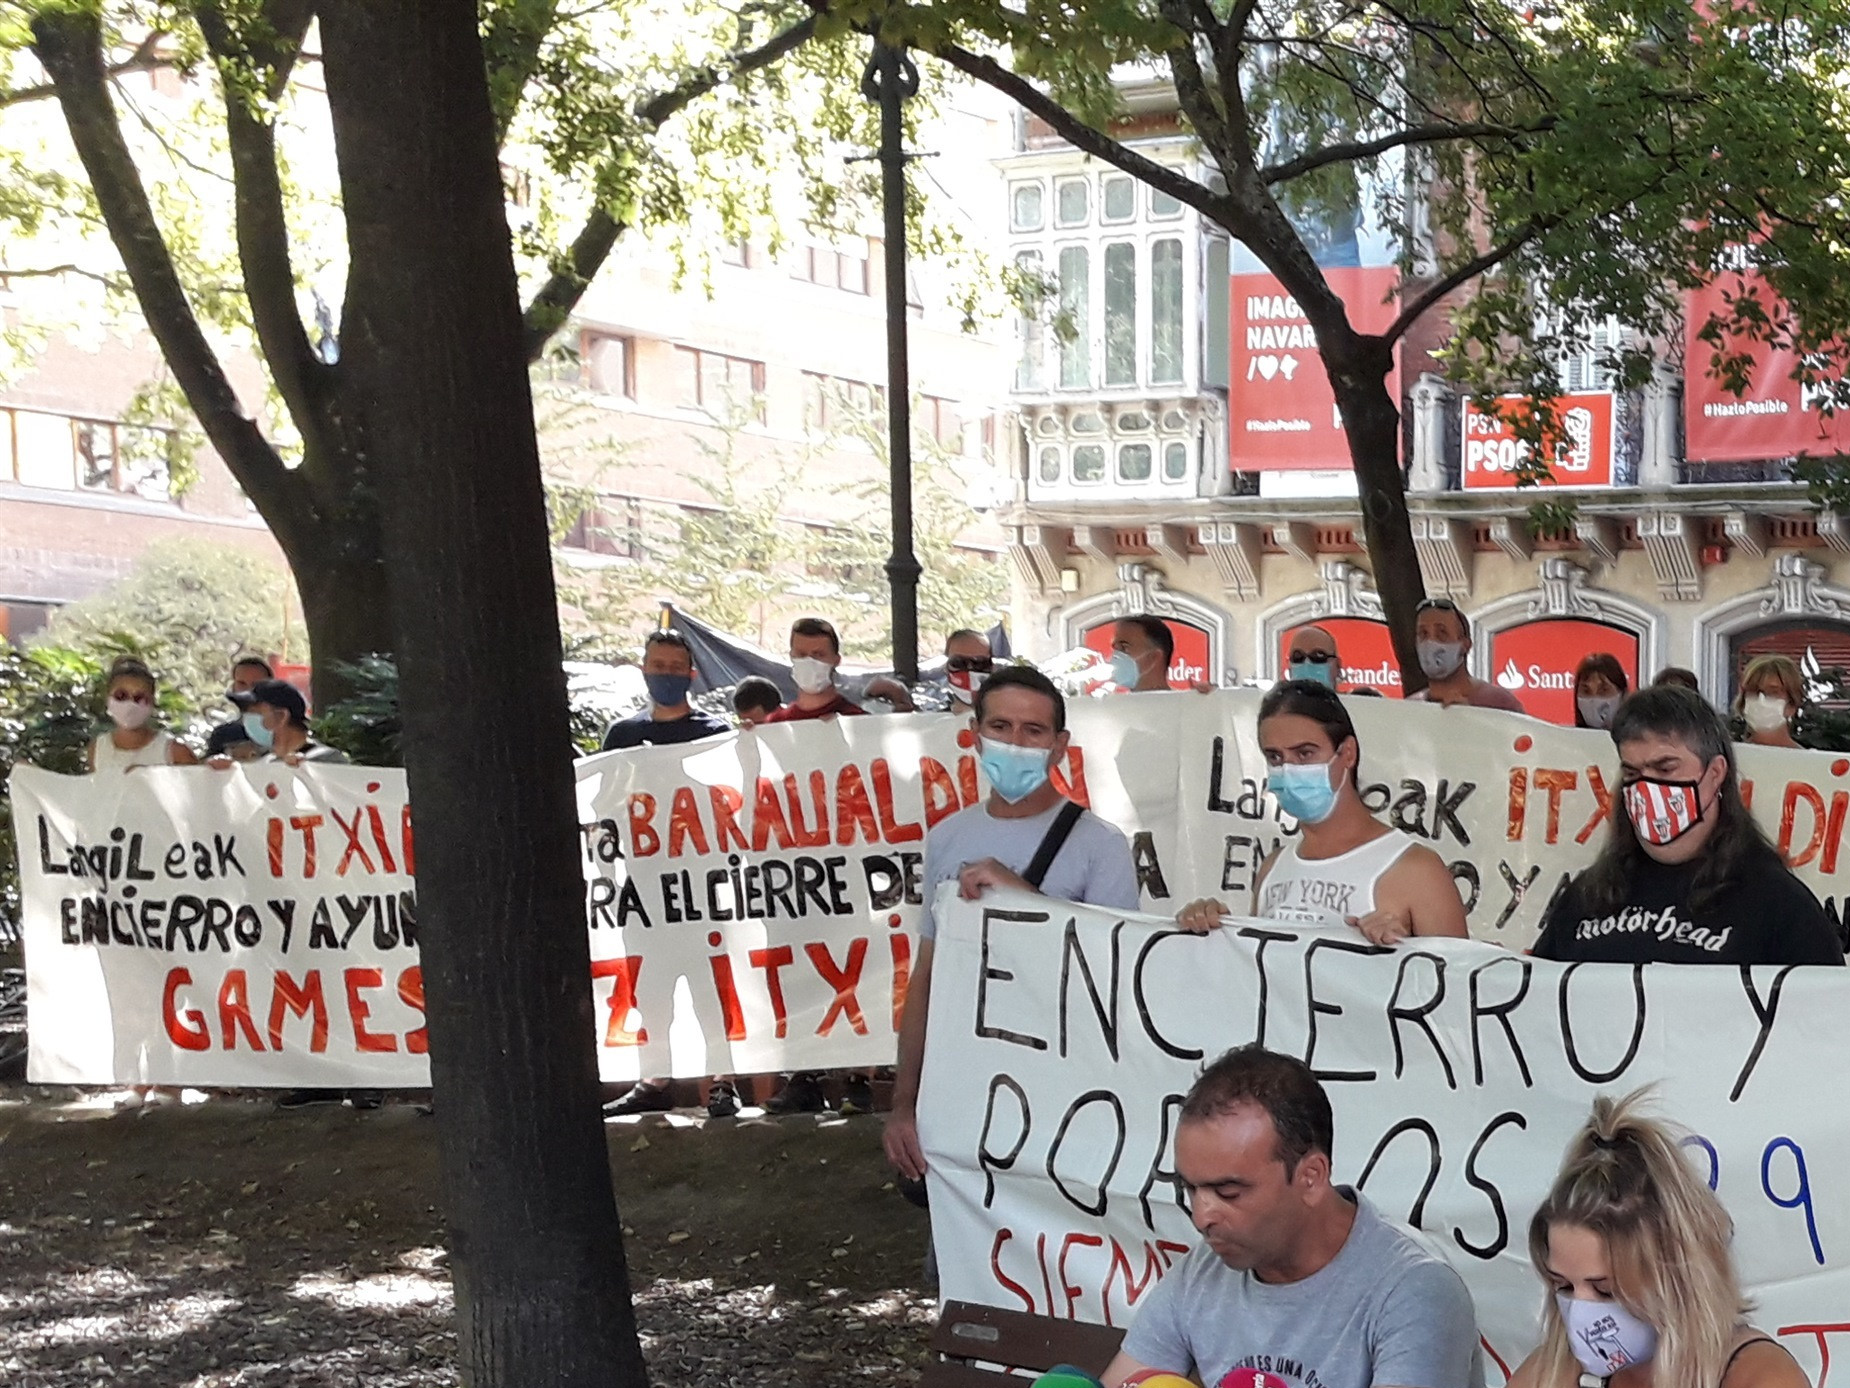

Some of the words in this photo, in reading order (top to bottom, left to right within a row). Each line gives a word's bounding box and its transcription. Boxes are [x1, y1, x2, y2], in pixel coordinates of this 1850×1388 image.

[1246, 295, 1307, 320] IMAG
[1246, 324, 1320, 350] NAVAR
[1299, 878, 1357, 916] YORK
[270, 898, 296, 954] Y
[1729, 964, 1796, 1103] Y
[1275, 1356, 1304, 1380] UNA
